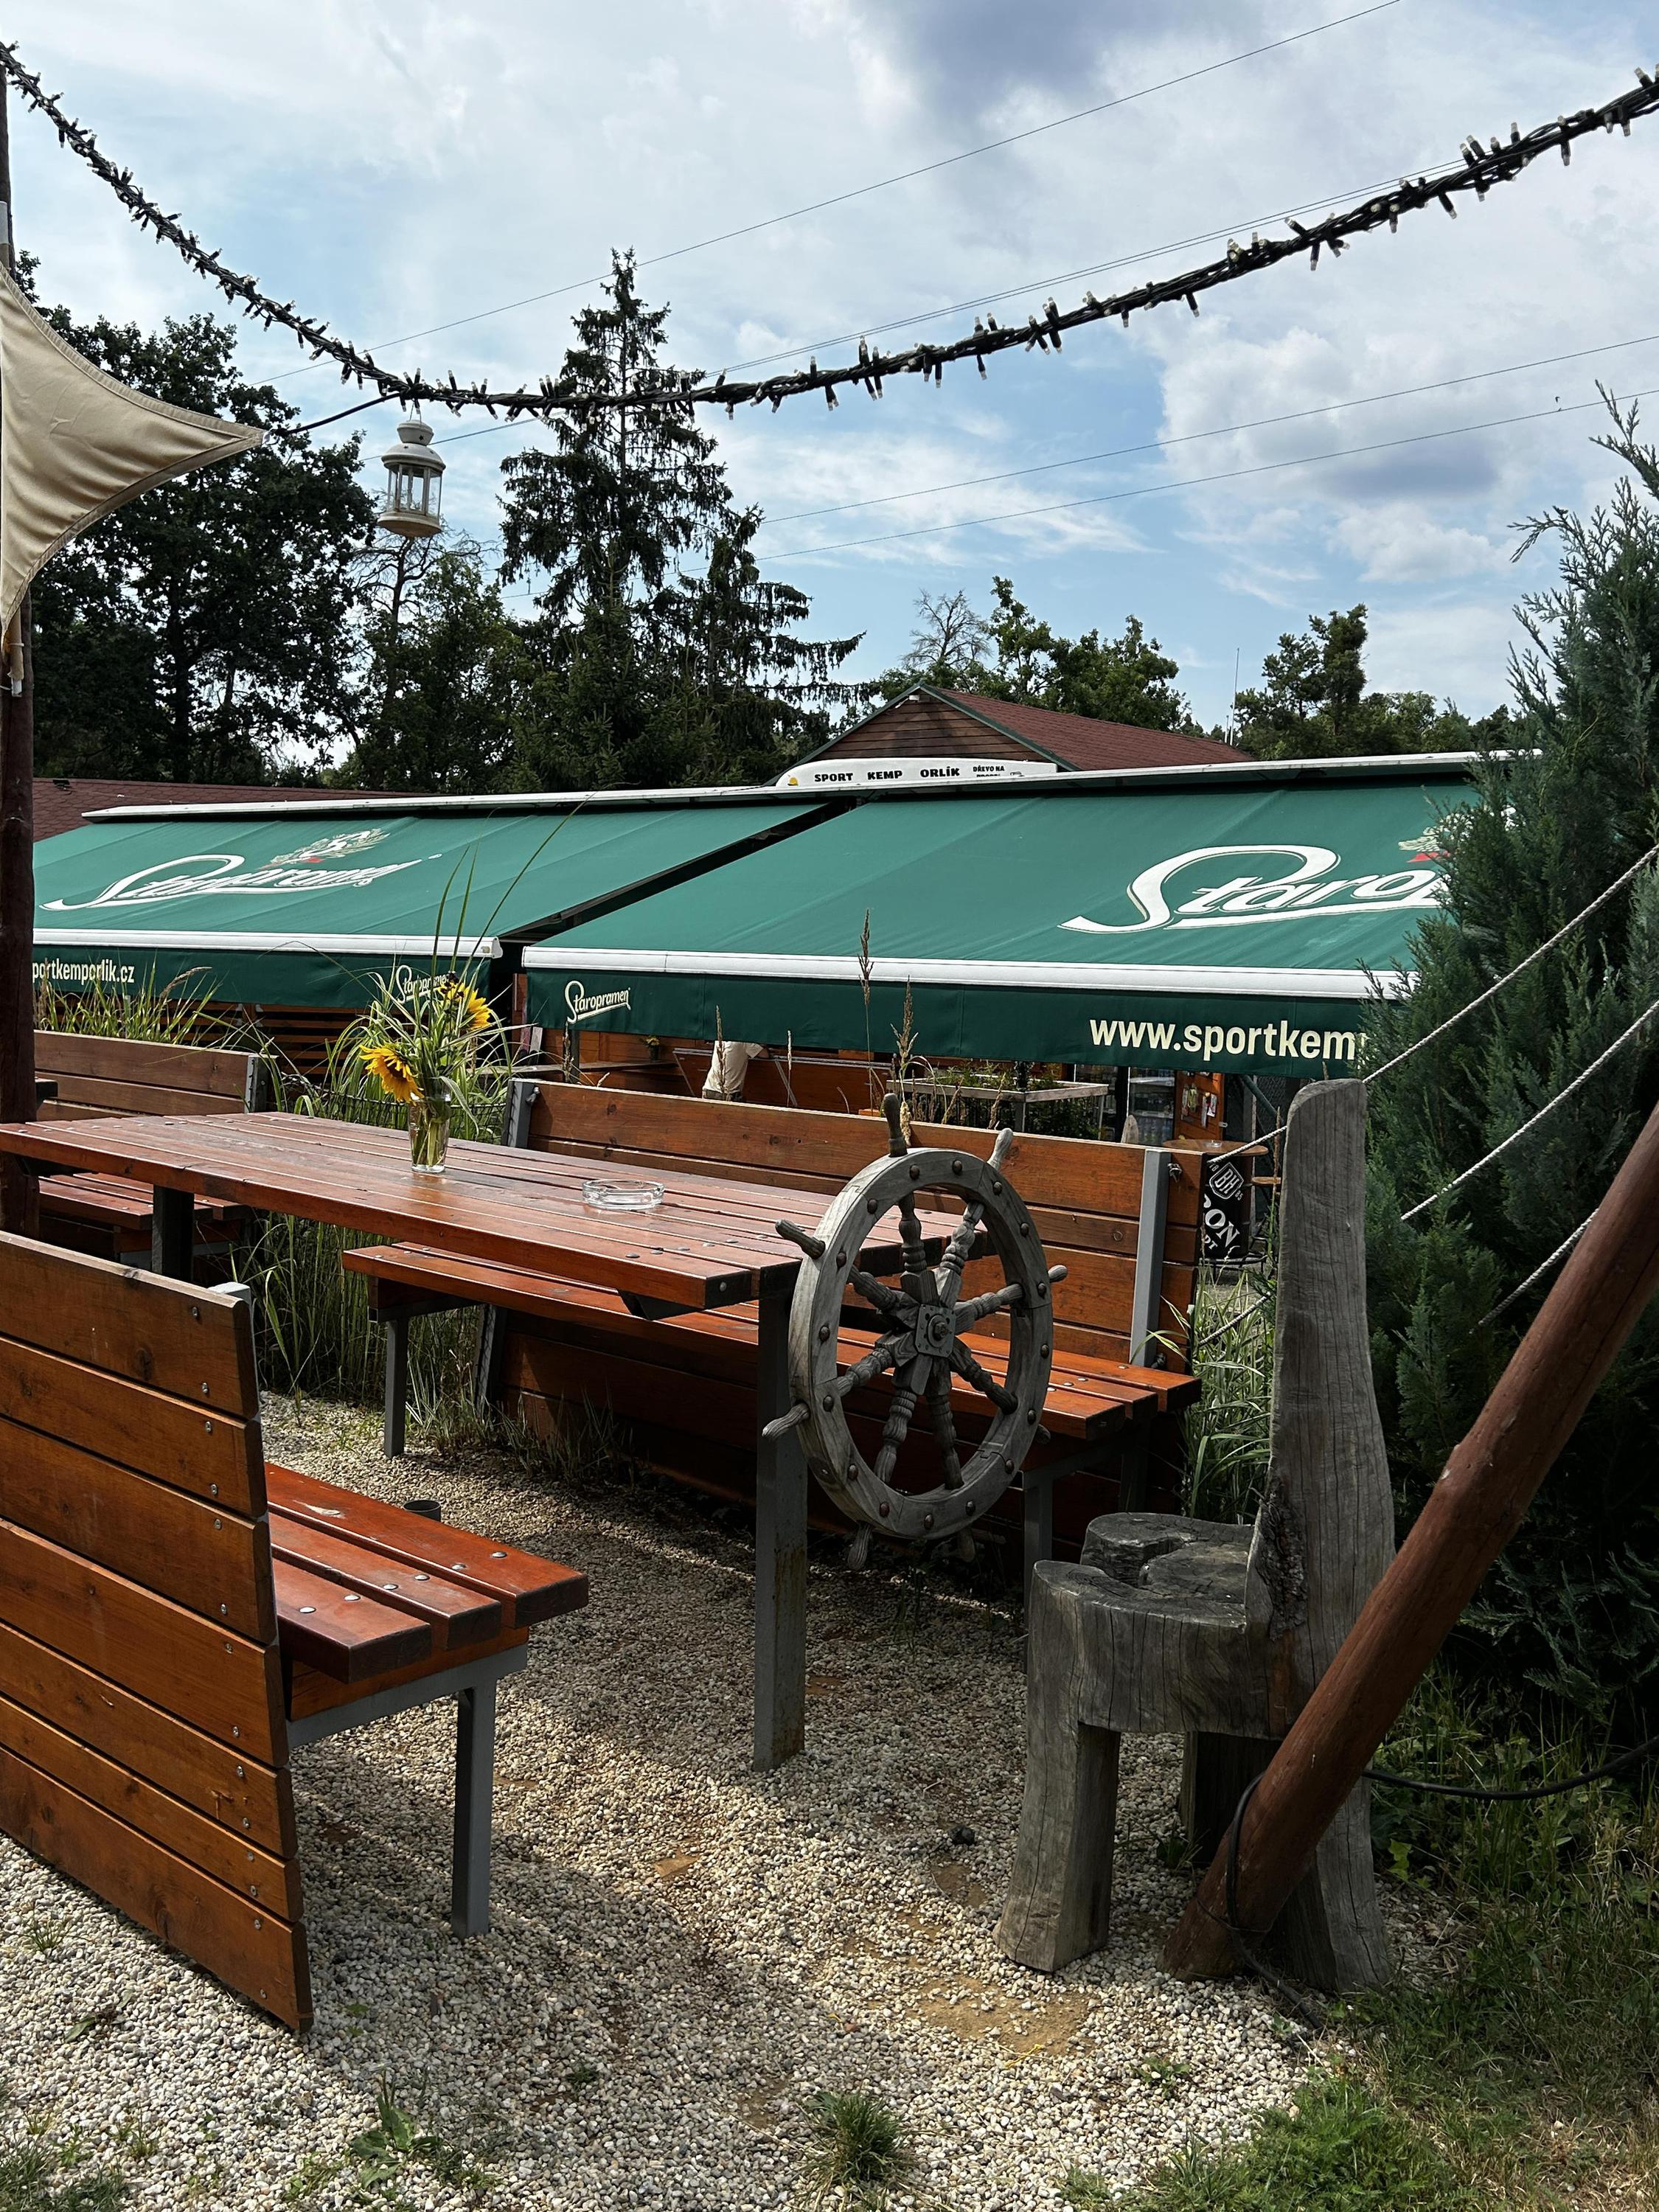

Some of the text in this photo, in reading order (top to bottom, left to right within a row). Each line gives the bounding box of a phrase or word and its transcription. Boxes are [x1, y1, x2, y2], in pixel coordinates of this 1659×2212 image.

[814, 766, 960, 782] SPORT KEMP ORLÍK
[32, 958, 135, 985] portkemporlik.cz
[565, 980, 631, 1024] Staropramen
[1214, 1169, 1240, 1194] BH
